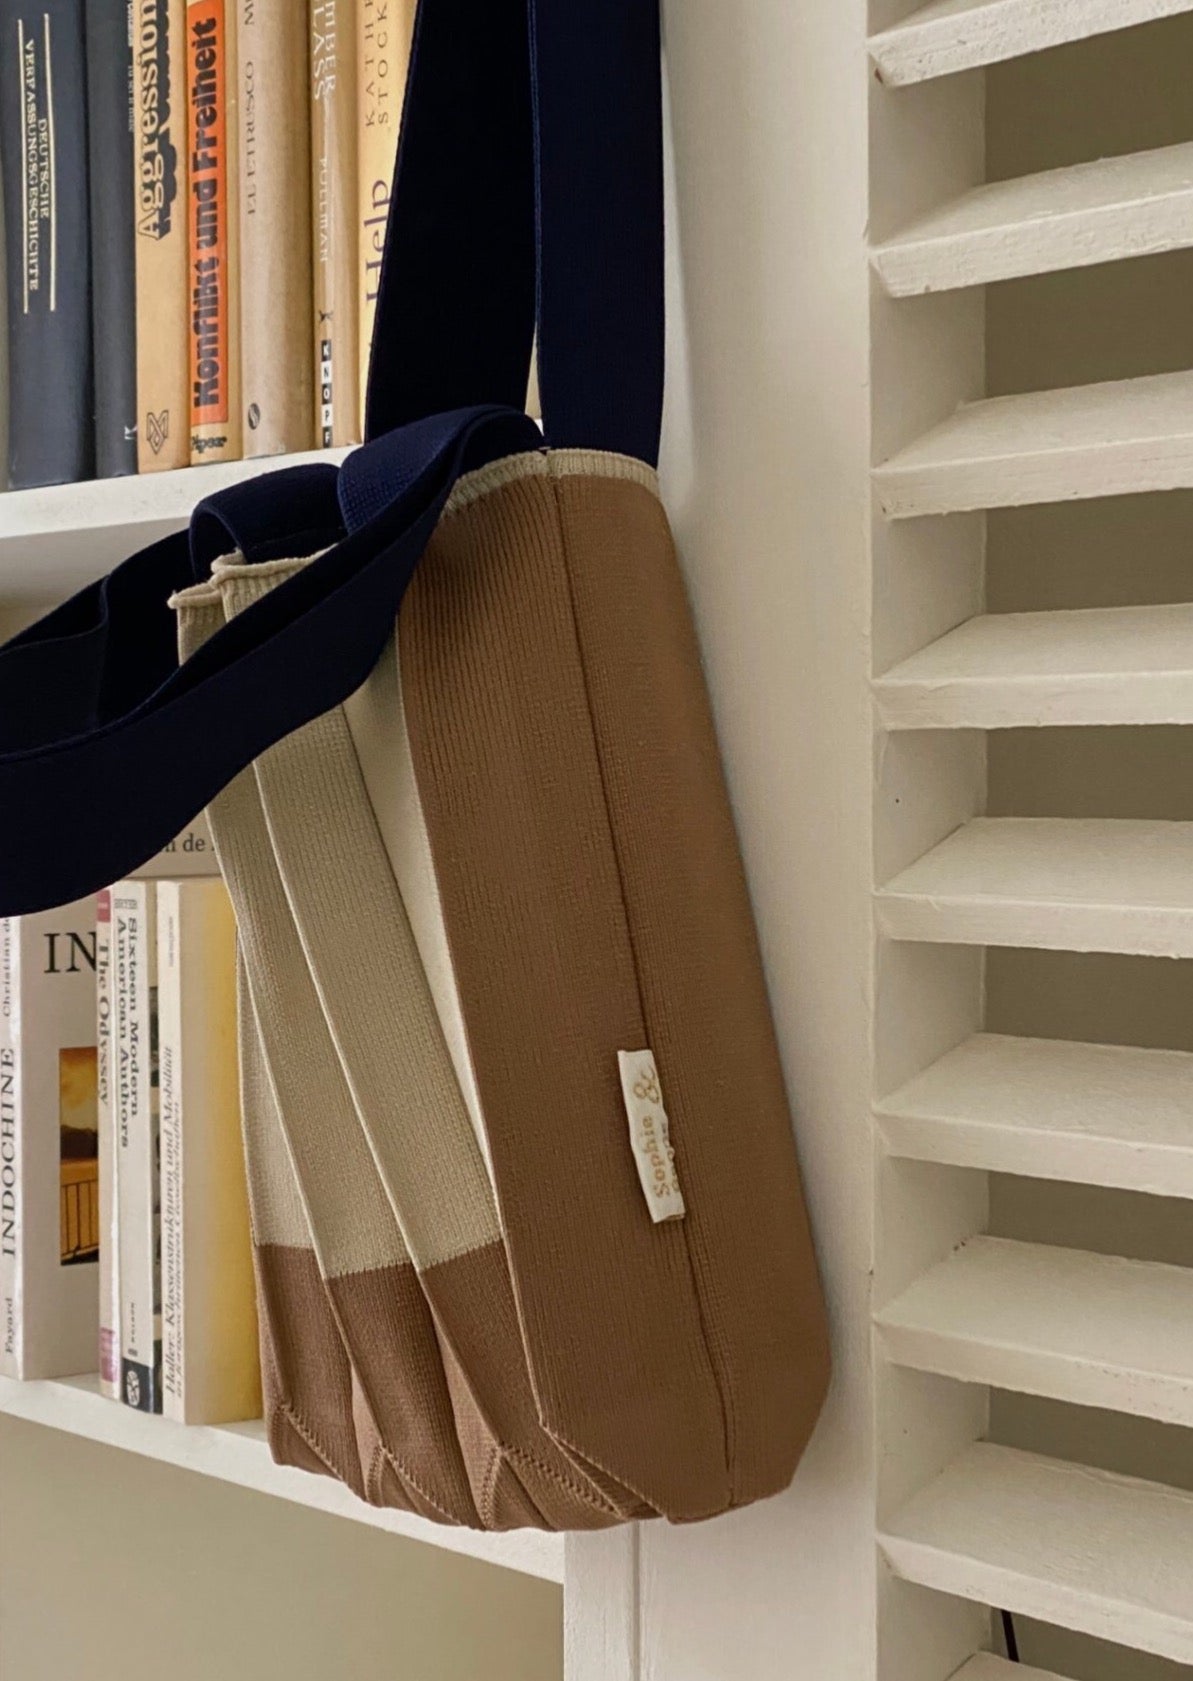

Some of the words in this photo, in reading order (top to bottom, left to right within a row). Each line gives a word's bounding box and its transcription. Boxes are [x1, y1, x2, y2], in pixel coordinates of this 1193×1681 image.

[191, 16, 218, 172] Freiheit
[313, 0, 325, 100] LASS
[24, 38, 40, 291] VERFASSUNGSGESCHICHTE
[38, 117, 49, 219] DEUTSCHE
[137, 0, 168, 240] Aggression
[194, 177, 218, 249] und
[194, 256, 220, 408] Konflikt
[182, 832, 206, 852] de
[44, 931, 97, 974] IN
[98, 938, 110, 988] The
[117, 917, 129, 1040] American
[127, 916, 139, 1012] Sixteen
[98, 996, 110, 1107] Odyssey
[119, 1048, 131, 1149] Authors
[130, 1022, 141, 1118] Modern
[1, 1048, 16, 1257] INDOCHINE
[164, 1129, 174, 1167] und
[642, 1115, 671, 1198] Sophie
[5, 1298, 14, 1354] Fayard
